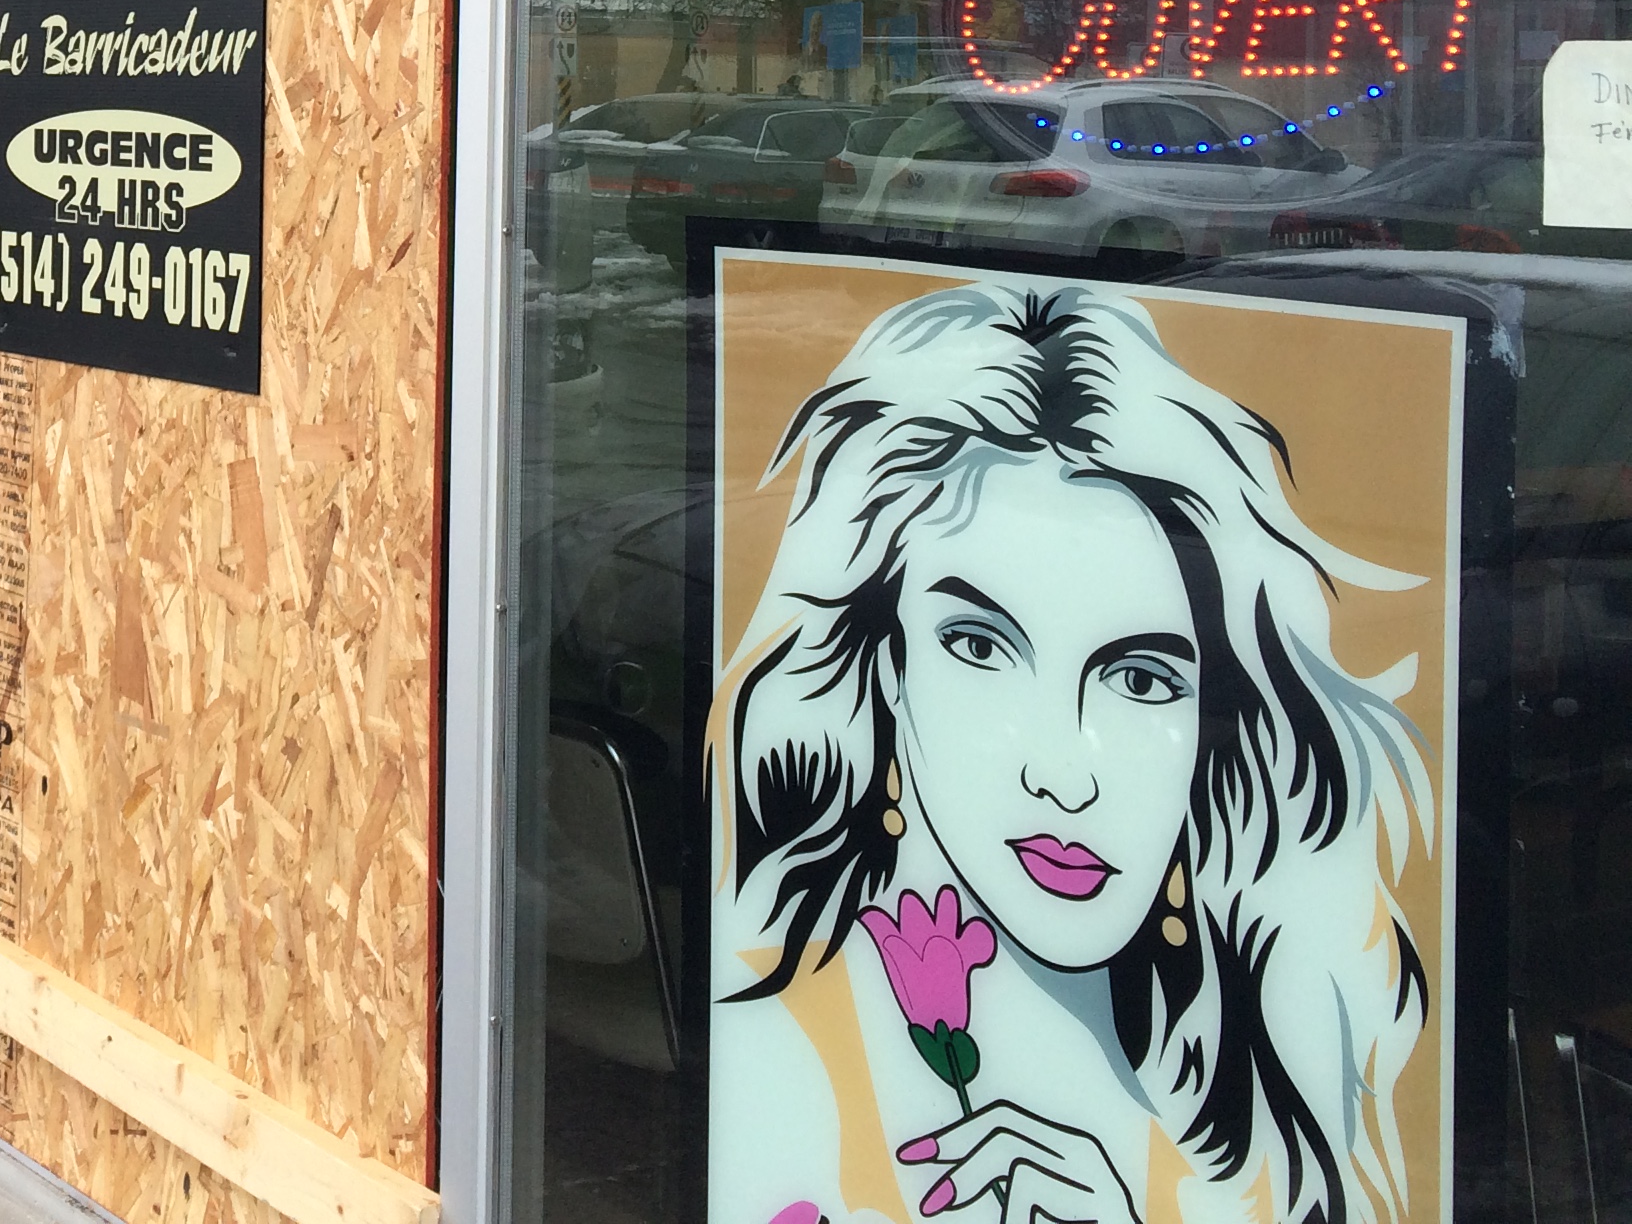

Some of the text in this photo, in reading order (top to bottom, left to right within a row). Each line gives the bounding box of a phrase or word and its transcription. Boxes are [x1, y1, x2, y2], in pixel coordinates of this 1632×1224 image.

[41, 7, 257, 76] Barricadeur
[33, 128, 214, 172] URGENCE
[55, 174, 186, 233] 24 HRS
[81, 237, 251, 334] 249-0167
